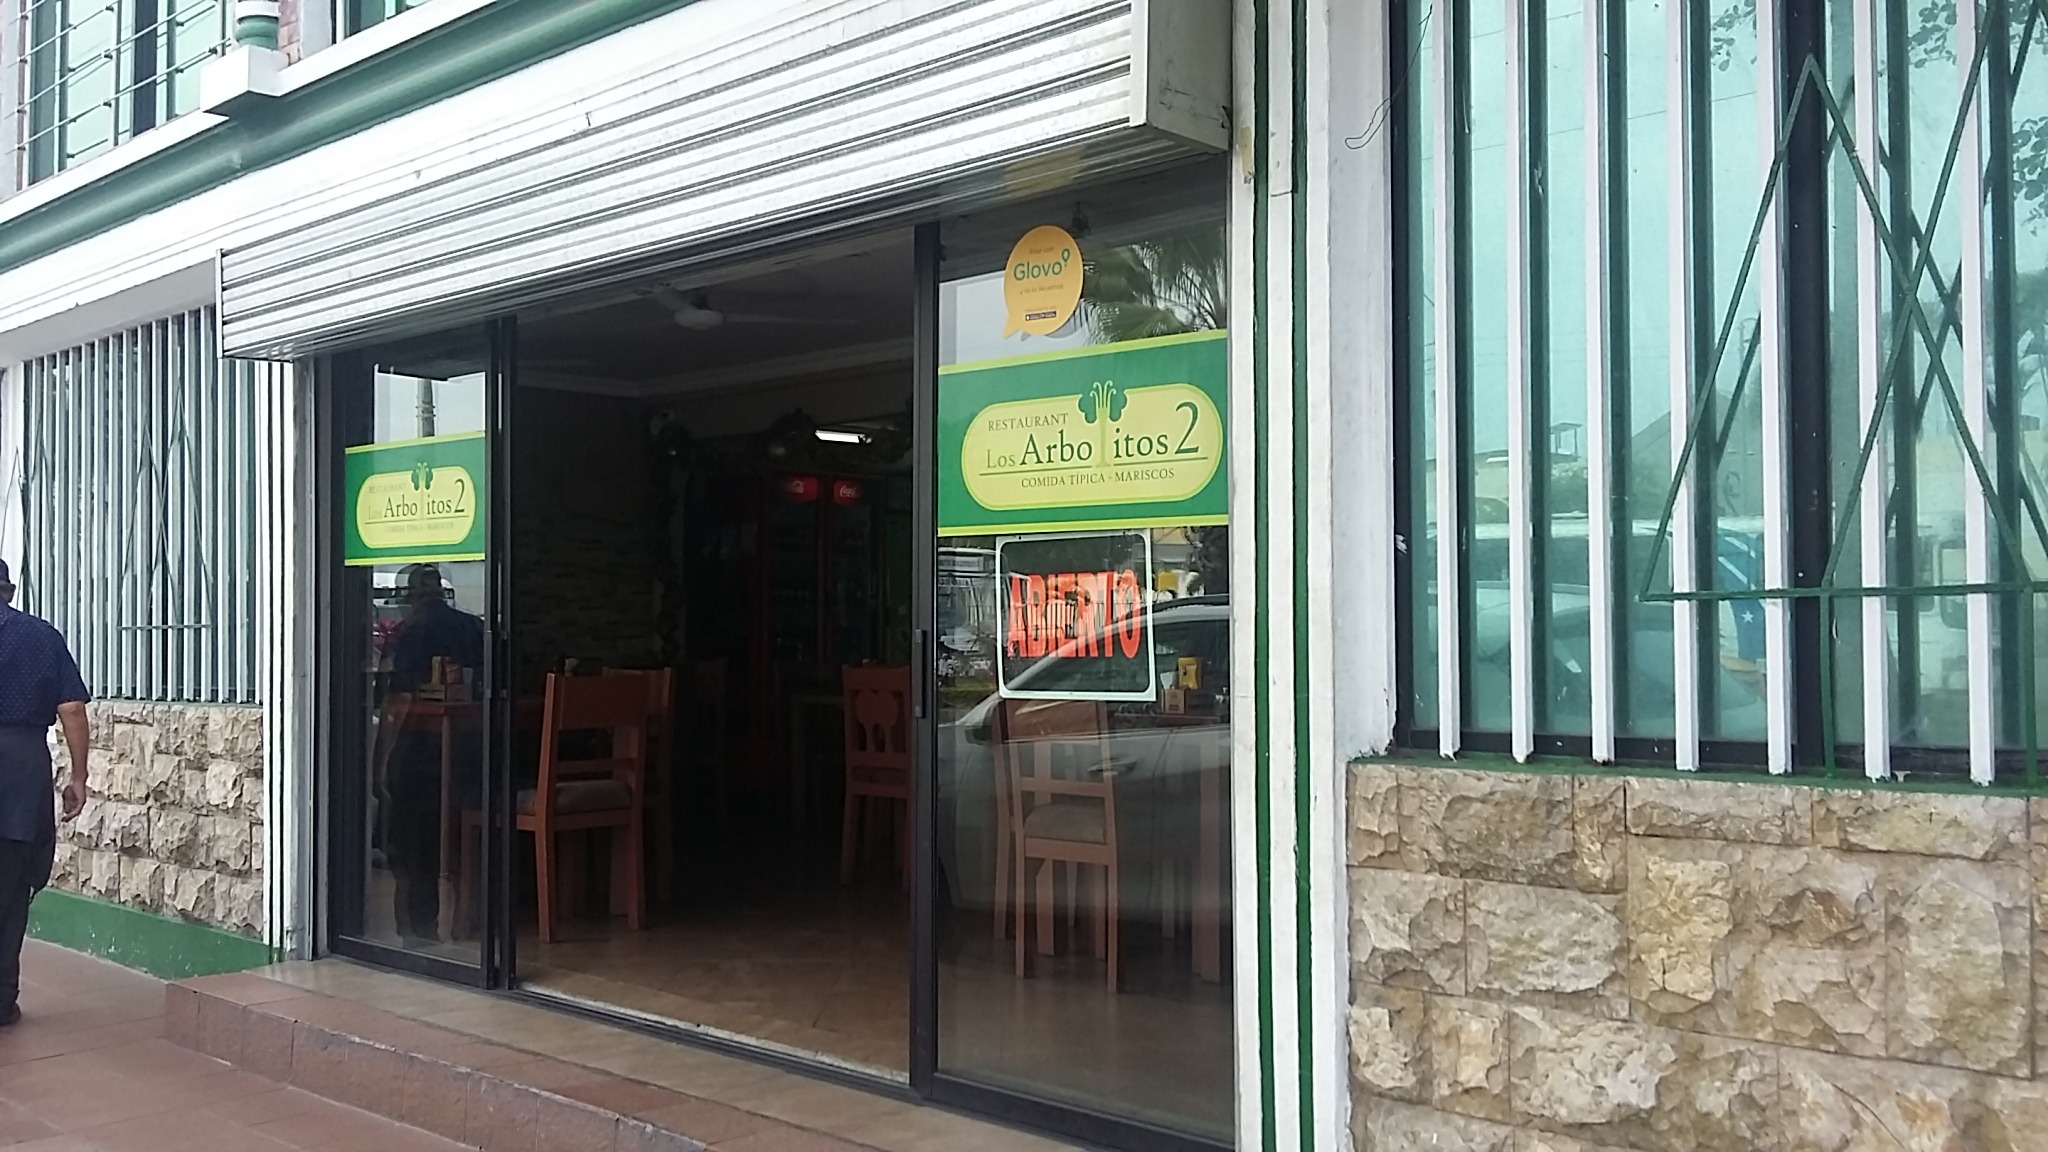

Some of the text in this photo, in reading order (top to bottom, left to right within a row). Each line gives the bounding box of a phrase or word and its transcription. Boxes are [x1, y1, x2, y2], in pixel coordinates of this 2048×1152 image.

[1013, 261, 1063, 281] Glovo
[988, 413, 1069, 431] RESTAURANT
[986, 449, 1016, 468] Los
[1174, 401, 1200, 454] 2
[1021, 476, 1066, 488] COMIDA
[1115, 468, 1175, 482] MARISCOS
[1007, 569, 1141, 659] ABIERTO
